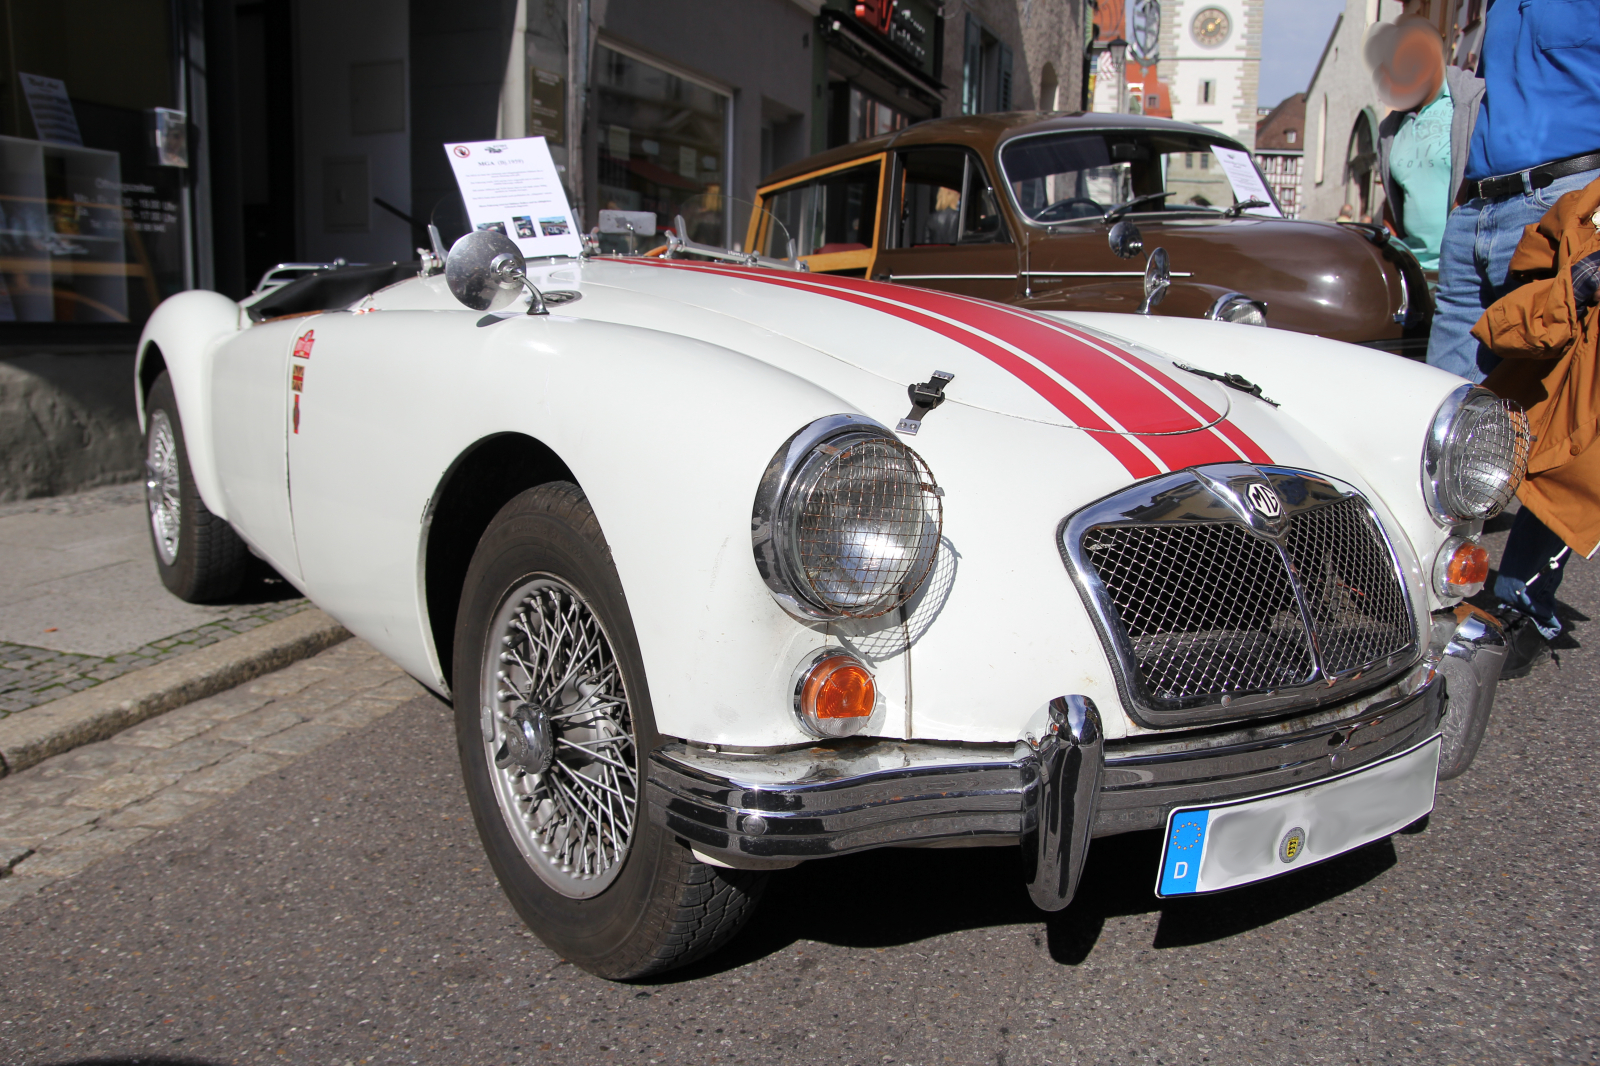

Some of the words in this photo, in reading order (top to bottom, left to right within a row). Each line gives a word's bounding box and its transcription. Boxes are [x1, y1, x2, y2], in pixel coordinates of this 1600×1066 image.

[1397, 157, 1447, 168] COAST
[1252, 485, 1278, 513] MG
[1173, 861, 1188, 880] D
